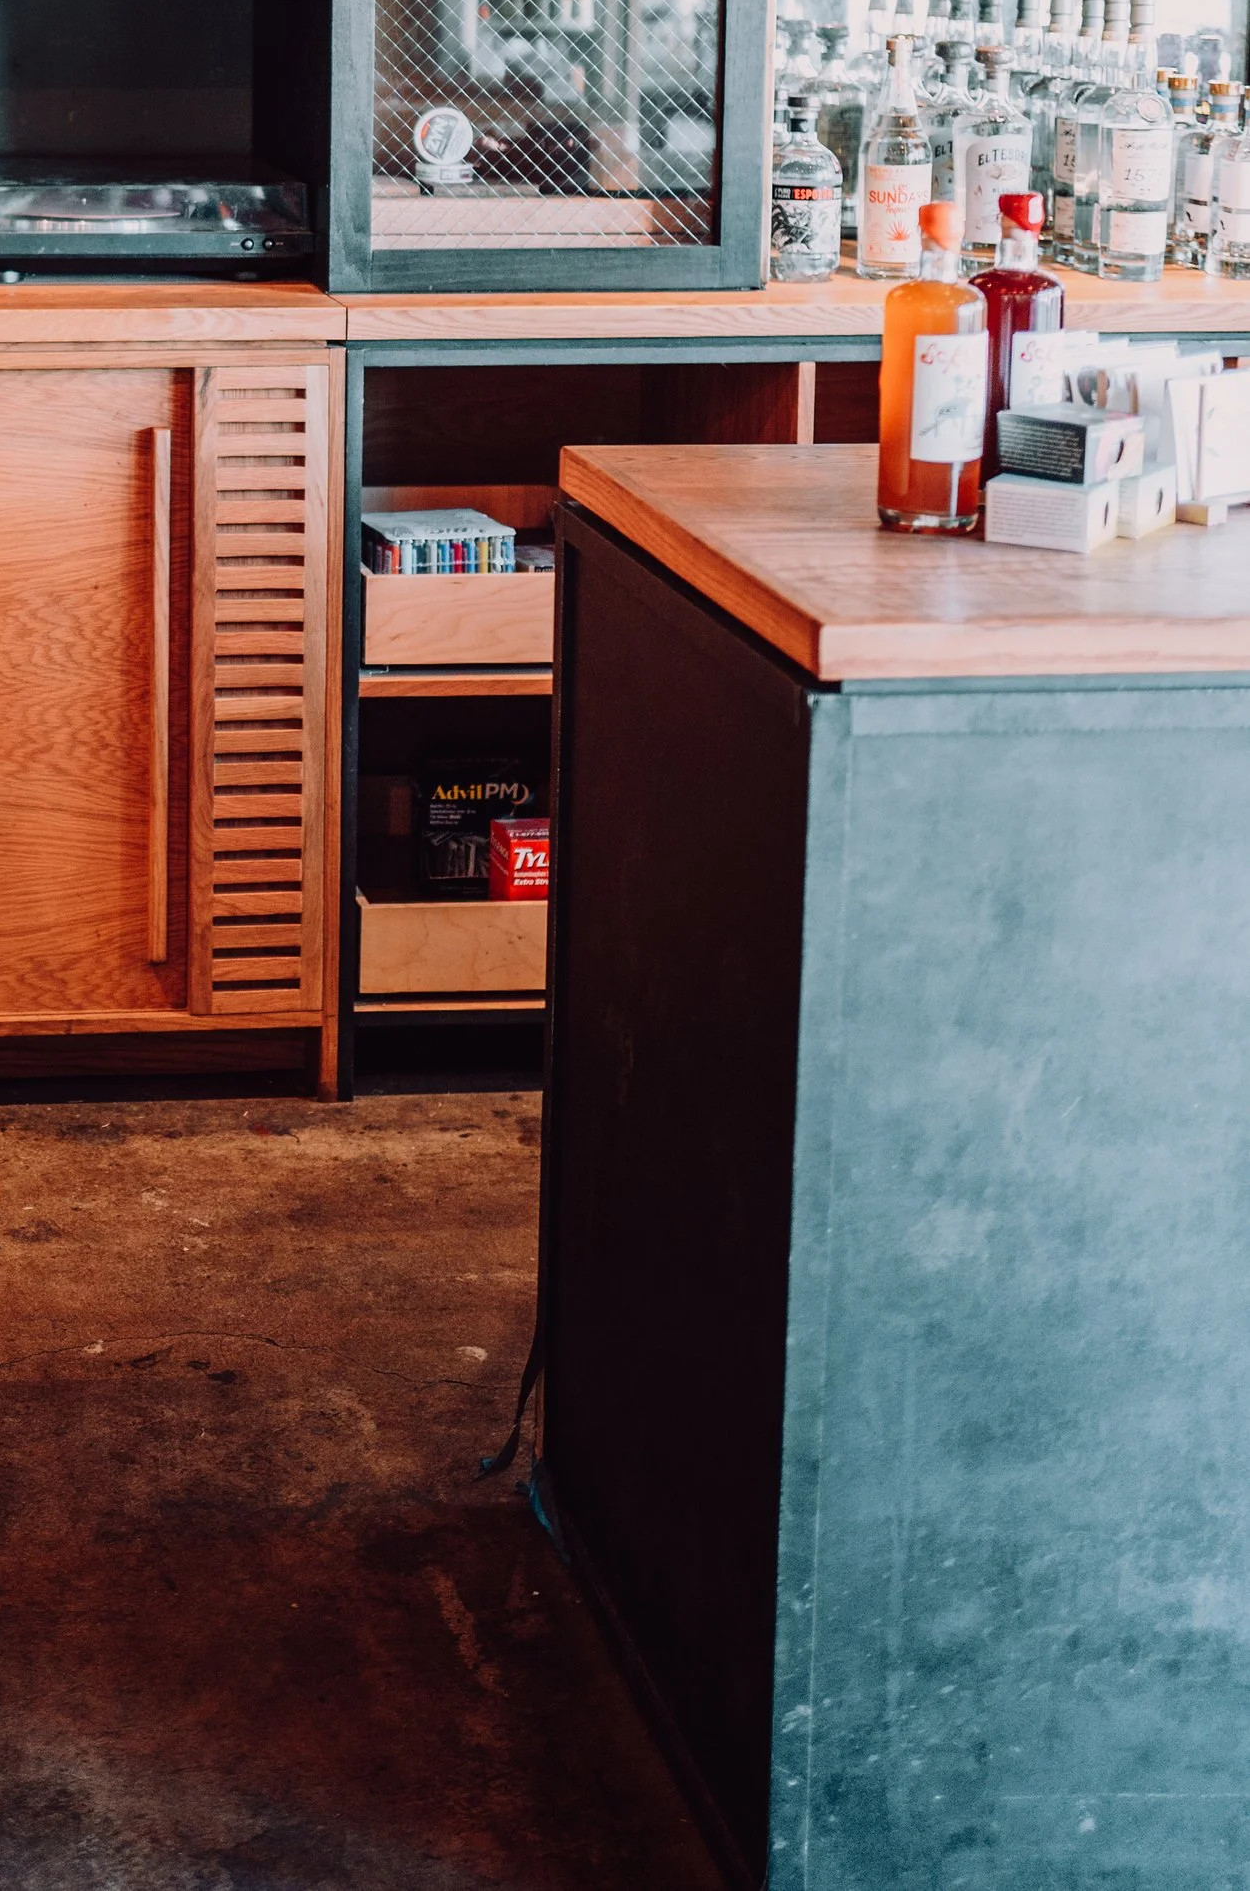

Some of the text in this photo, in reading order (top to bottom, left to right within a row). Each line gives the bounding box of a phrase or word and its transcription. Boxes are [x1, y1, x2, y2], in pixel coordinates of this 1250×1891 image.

[978, 153, 990, 166] EL
[869, 188, 929, 205] SUNDAYS
[432, 783, 519, 800] Advil PM
